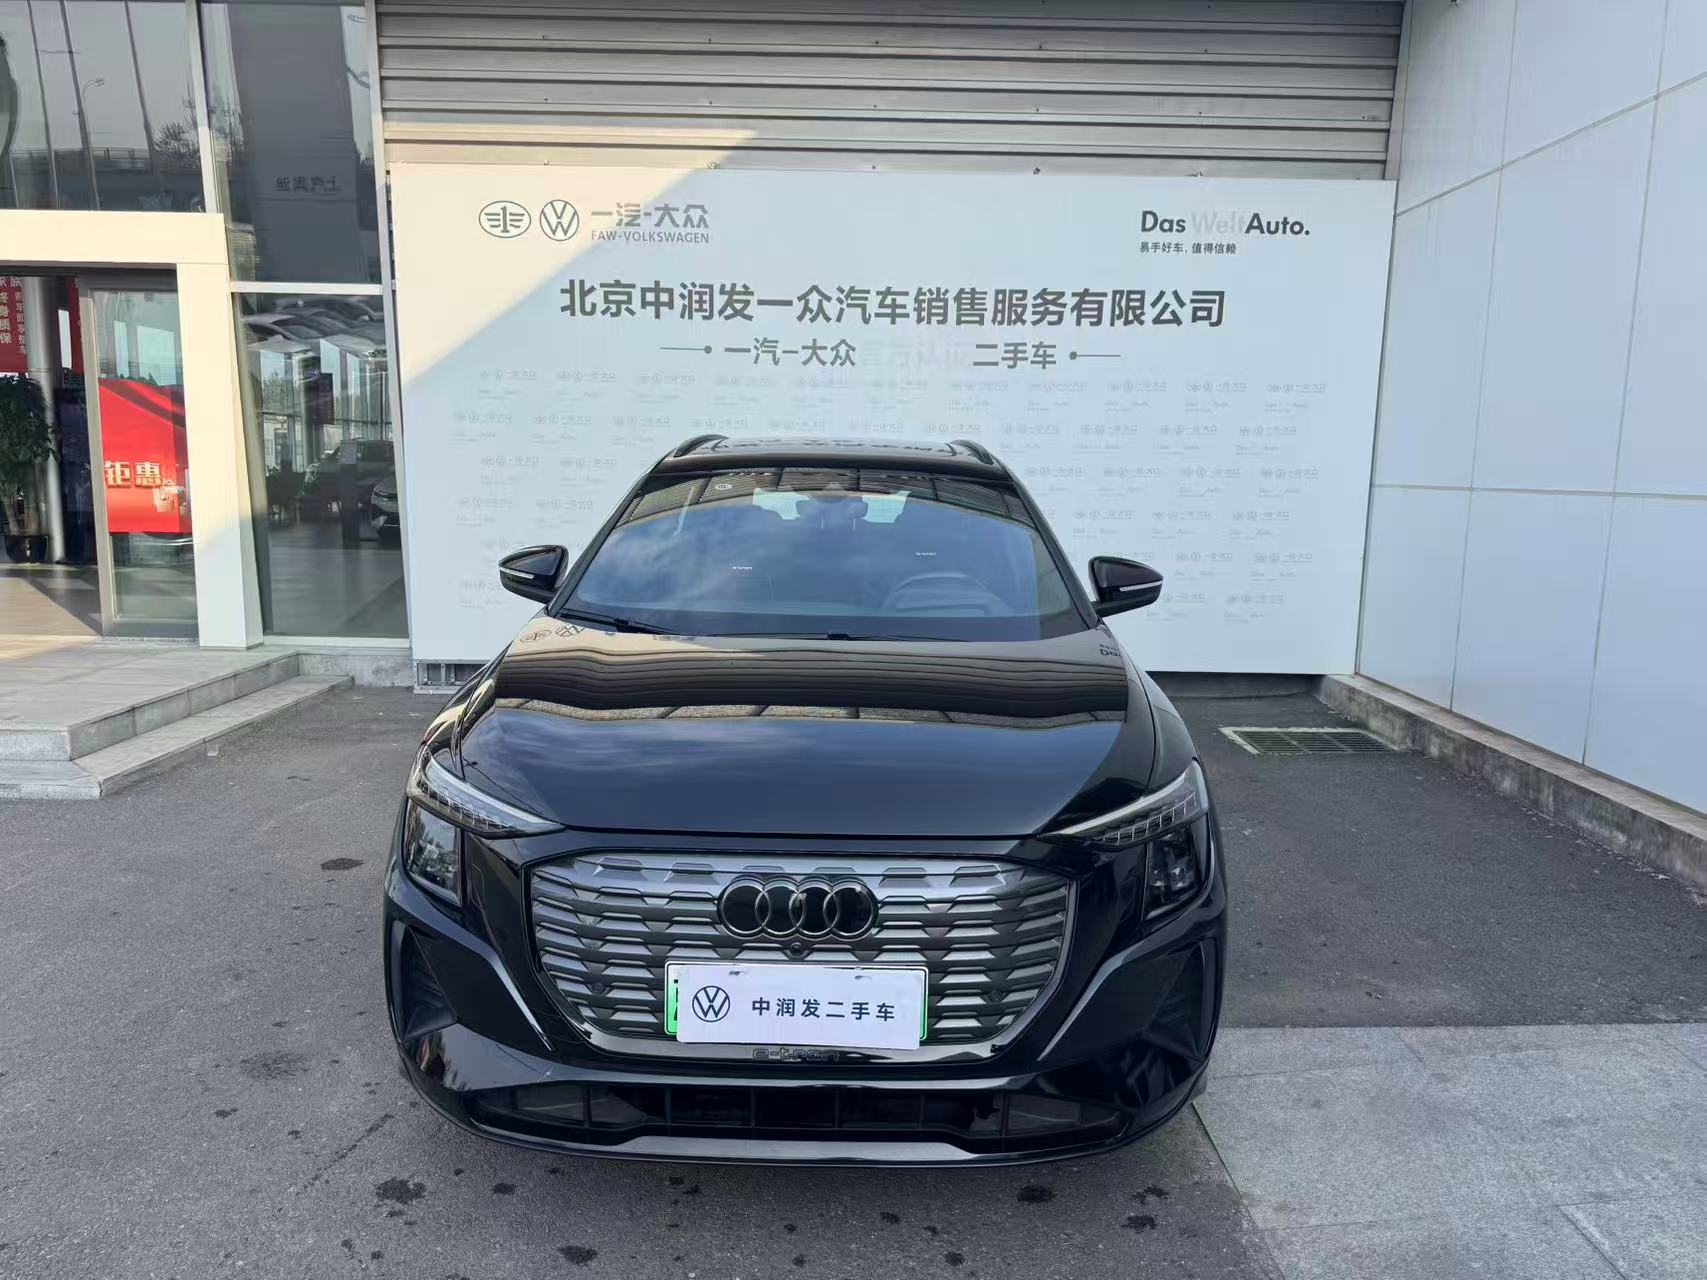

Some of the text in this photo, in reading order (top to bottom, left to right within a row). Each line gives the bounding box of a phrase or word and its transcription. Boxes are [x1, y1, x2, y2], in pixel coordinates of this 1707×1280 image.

[1141, 210, 1186, 233] Das
[1244, 212, 1310, 236] Auto.
[591, 230, 709, 244] FAW-VOLKSWAGEN
[560, 280, 1225, 328] 北京中润发一众汽车销售服务有限公司
[973, 341, 1057, 370] 二手车
[752, 997, 896, 1022] 中润发二手车
